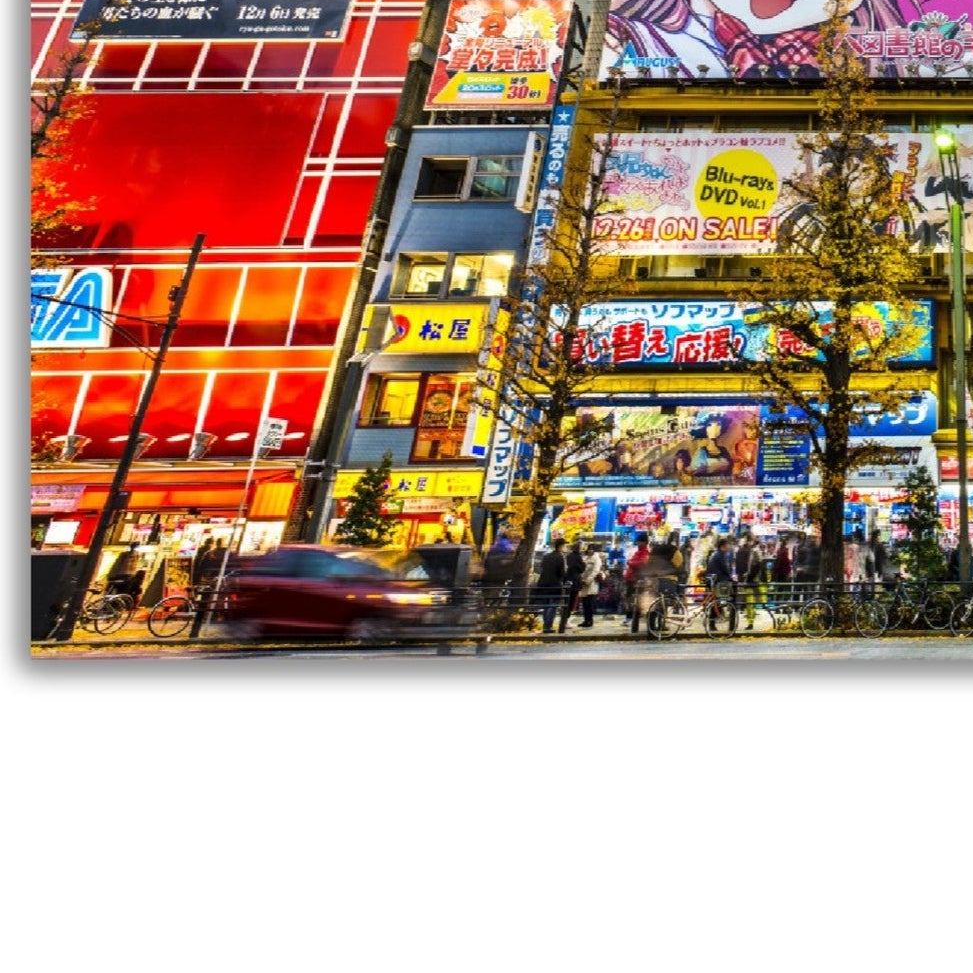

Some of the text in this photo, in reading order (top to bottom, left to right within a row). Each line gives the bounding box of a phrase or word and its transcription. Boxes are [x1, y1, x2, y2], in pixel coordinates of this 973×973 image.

[507, 85, 529, 99] 30
[700, 185, 738, 205] DVD
[658, 217, 699, 240] ON
[702, 217, 779, 240] SALE!
[419, 319, 471, 340] 松屋
